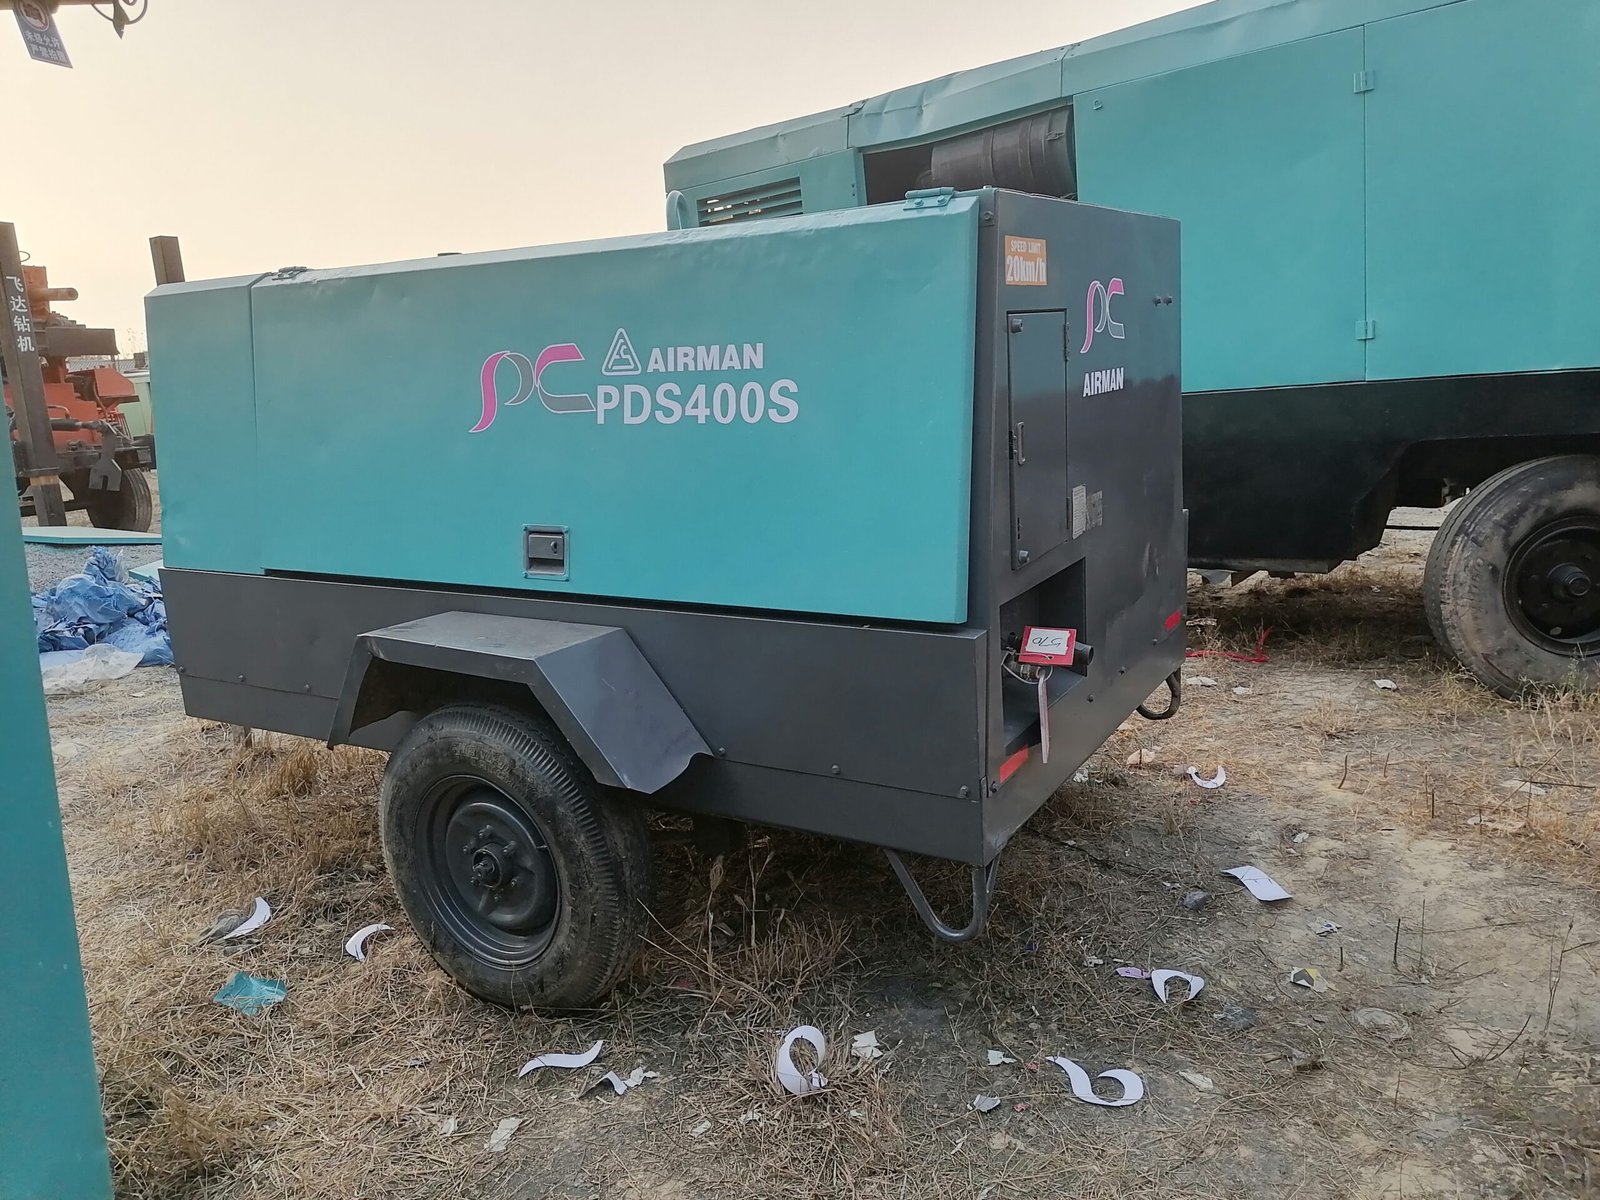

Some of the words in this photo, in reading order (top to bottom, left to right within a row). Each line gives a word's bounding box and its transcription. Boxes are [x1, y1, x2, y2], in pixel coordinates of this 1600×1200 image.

[1011, 239, 1027, 252] SPEED
[1028, 242, 1041, 254] LIMIT
[1006, 255, 1047, 282] 20km/h
[6, 275, 35, 352] 飞达钻机
[647, 343, 764, 373] AIRMAN
[1082, 367, 1124, 397] AIRMAN
[596, 379, 799, 425] PDS400S
